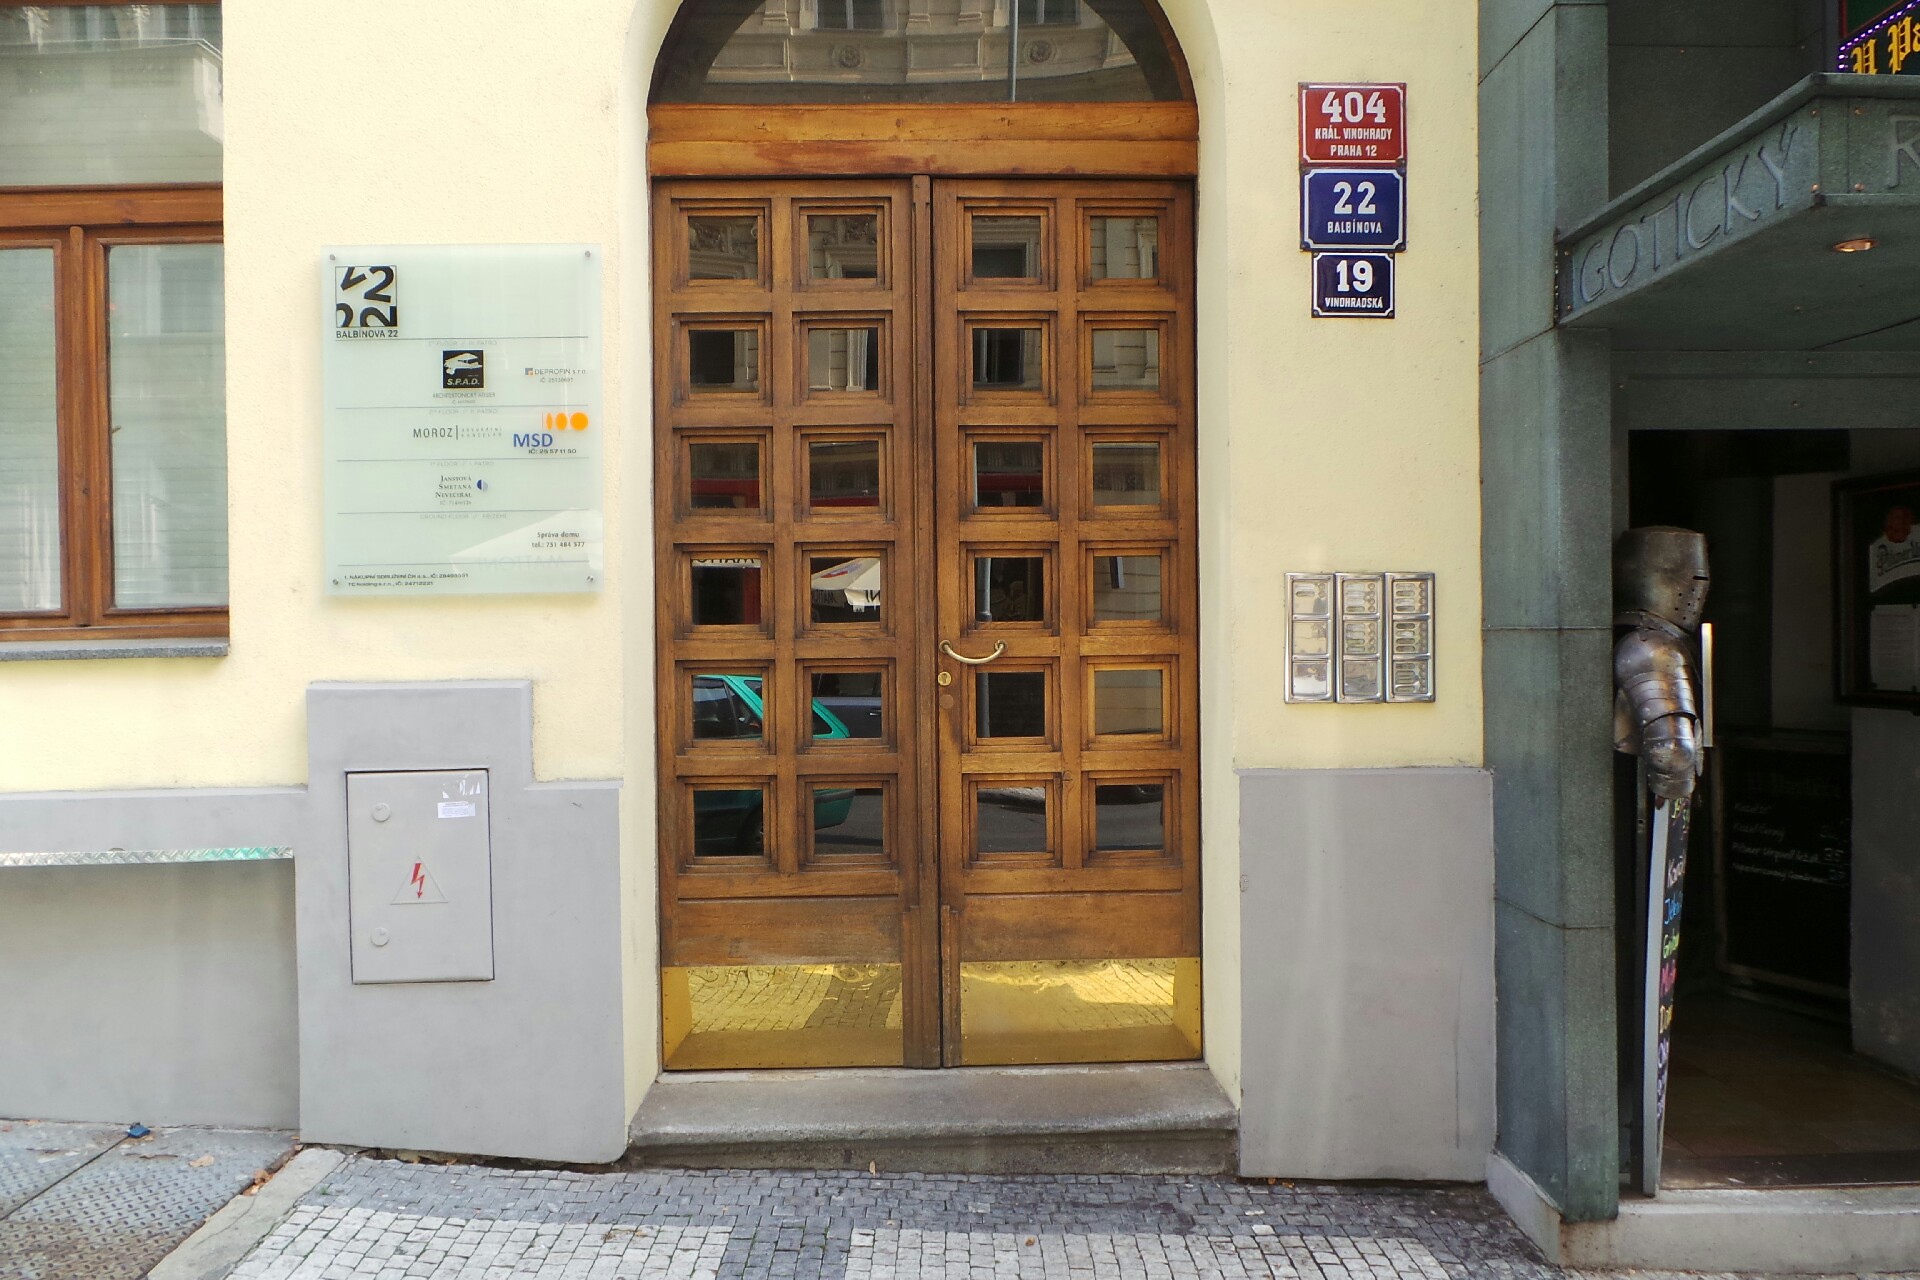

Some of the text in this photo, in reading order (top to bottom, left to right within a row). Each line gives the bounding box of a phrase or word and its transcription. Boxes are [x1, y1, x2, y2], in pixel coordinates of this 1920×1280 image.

[1321, 91, 1386, 123] 404
[1314, 125, 1393, 141] KRÁL. VINOHRADY
[1330, 144, 1378, 157] PRAHA 12
[1333, 181, 1376, 215] 22
[1327, 219, 1382, 234] BALBÍNOVA
[1336, 260, 1374, 292] 19
[1324, 296, 1384, 309] VINOHRADSKÁ
[388, 329, 398, 338] 22
[534, 367, 572, 375] DEPROFIN
[446, 378, 480, 386] S.P.A.D.
[413, 427, 454, 439] MOROZ
[513, 432, 554, 448] MSD
[560, 530, 580, 538] domu
